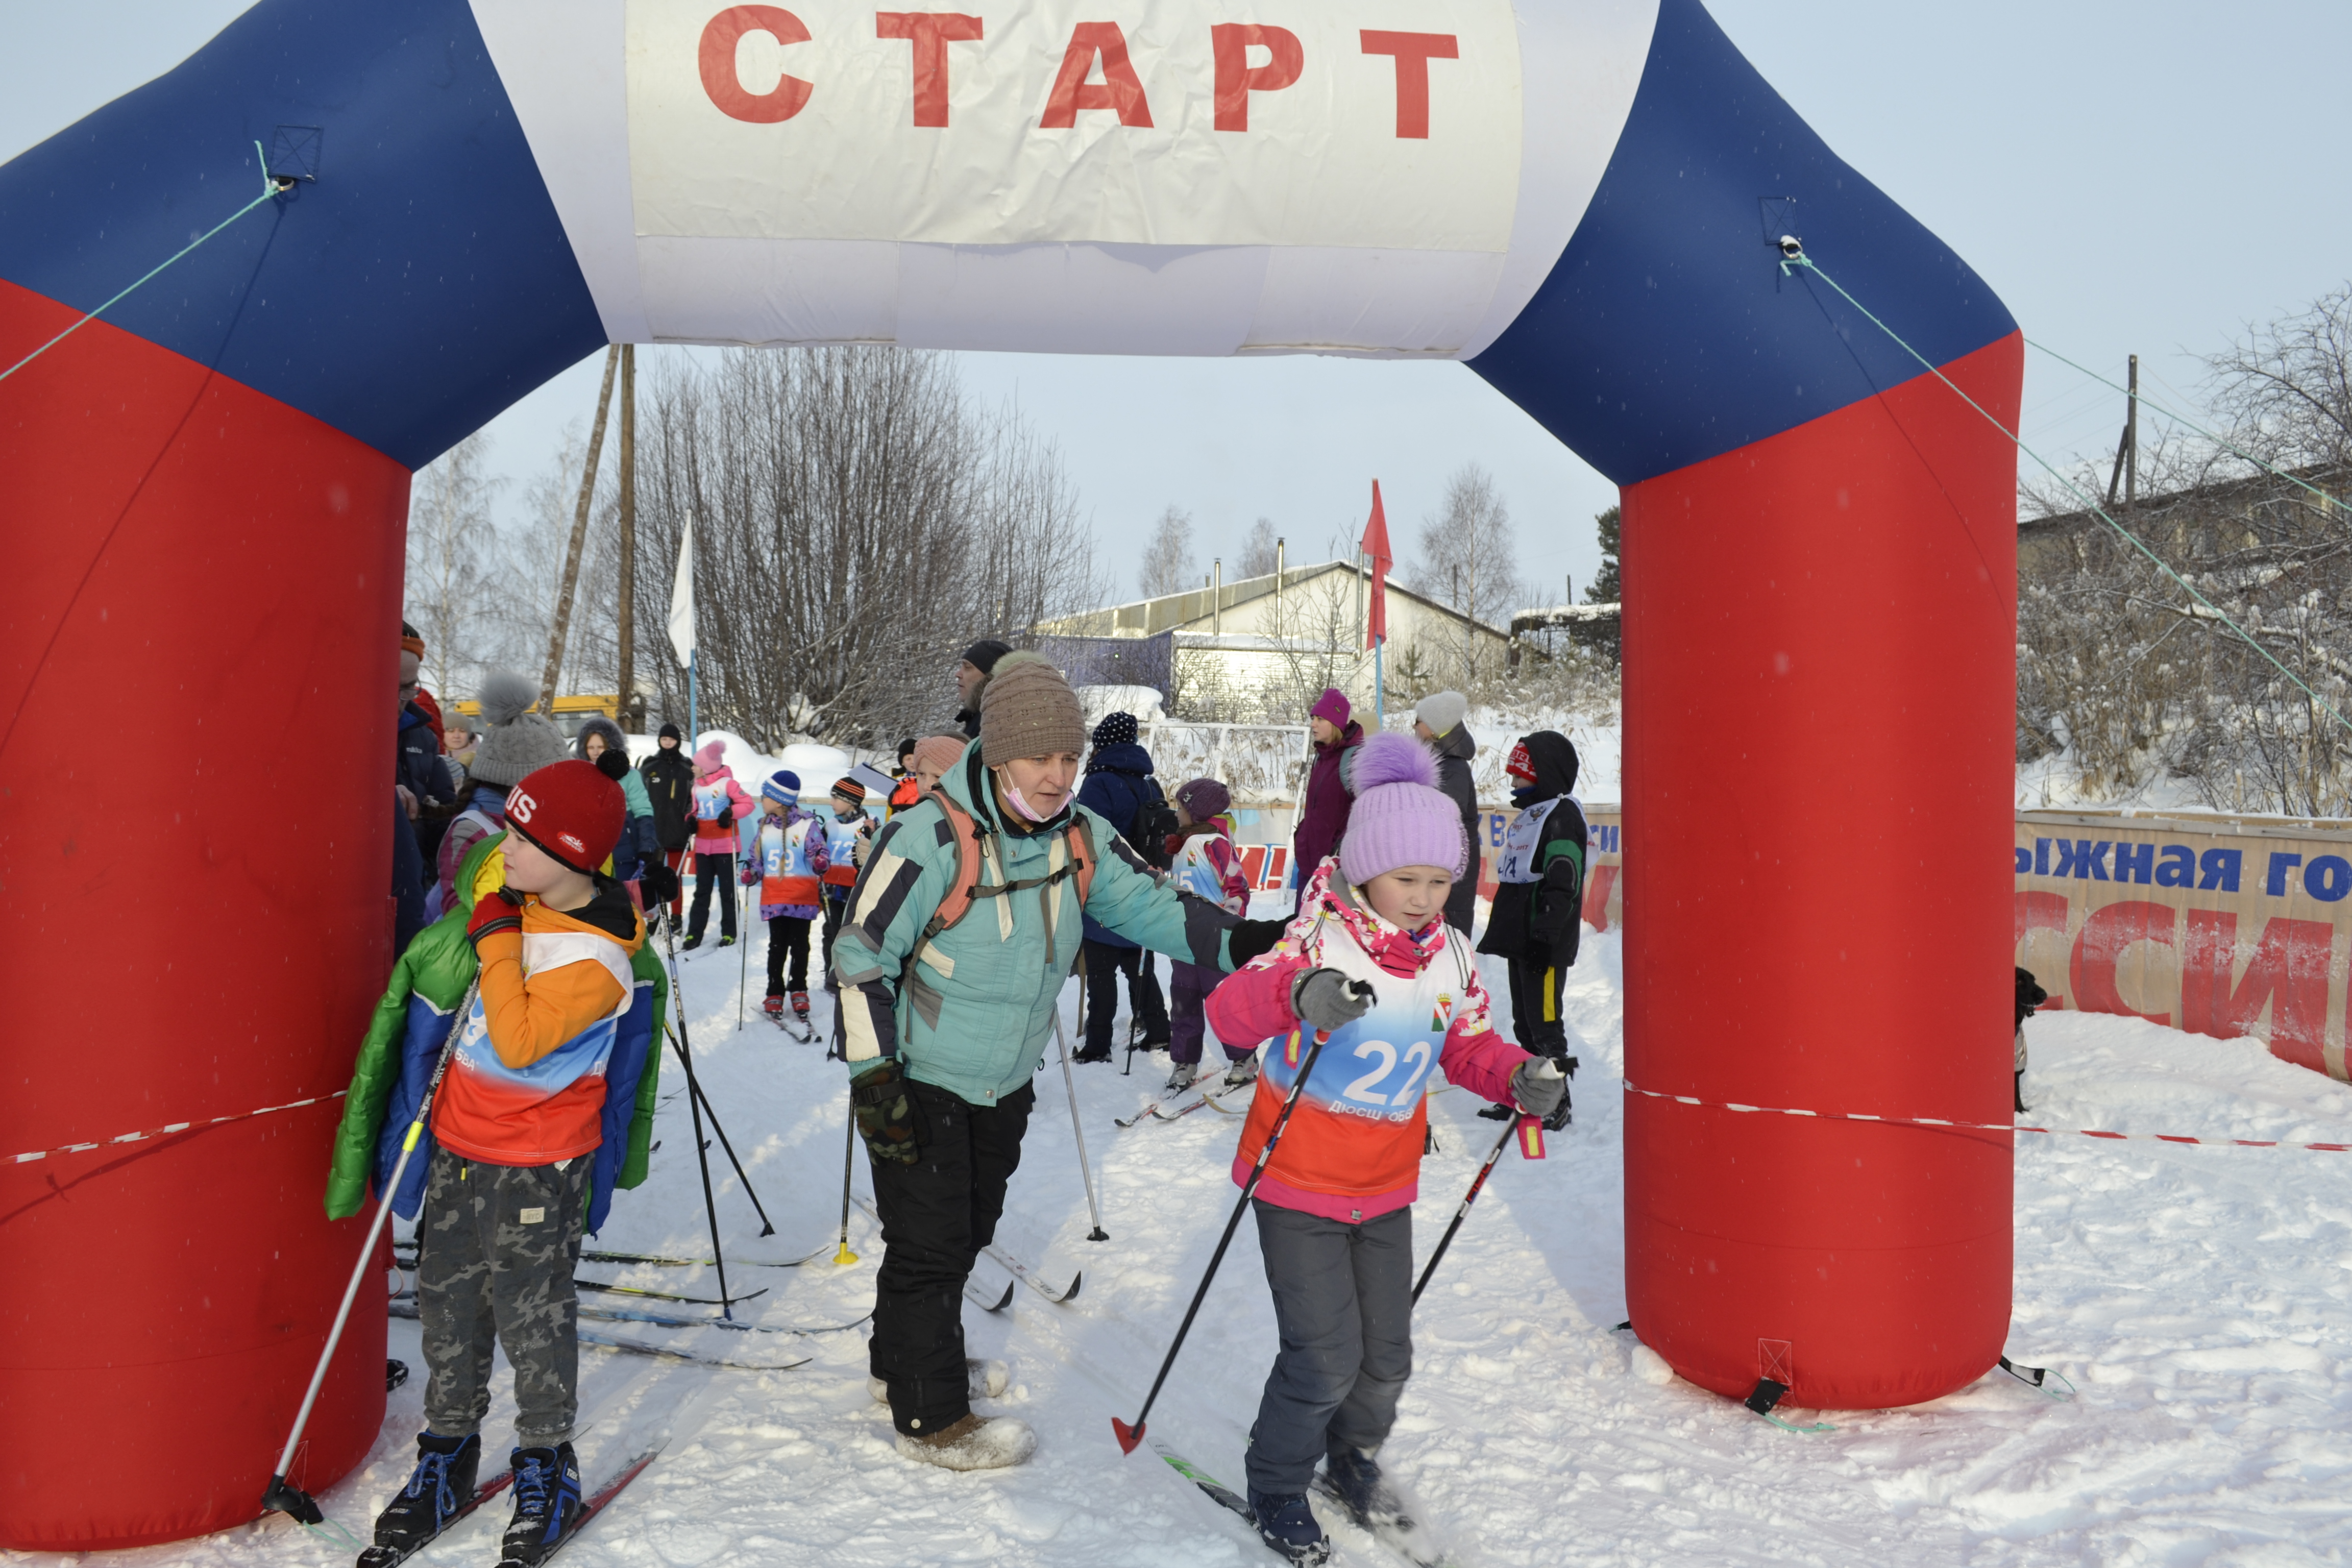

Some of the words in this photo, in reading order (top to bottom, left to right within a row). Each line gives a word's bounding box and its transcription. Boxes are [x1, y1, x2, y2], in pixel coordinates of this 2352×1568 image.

[698, 4, 1460, 139] СТАРТ
[698, 800, 715, 817] 41
[767, 849, 795, 871] 59
[830, 840, 853, 862] 72
[1342, 1040, 1432, 1107] 22
[1328, 1100, 1383, 1121] ДЮСШ
